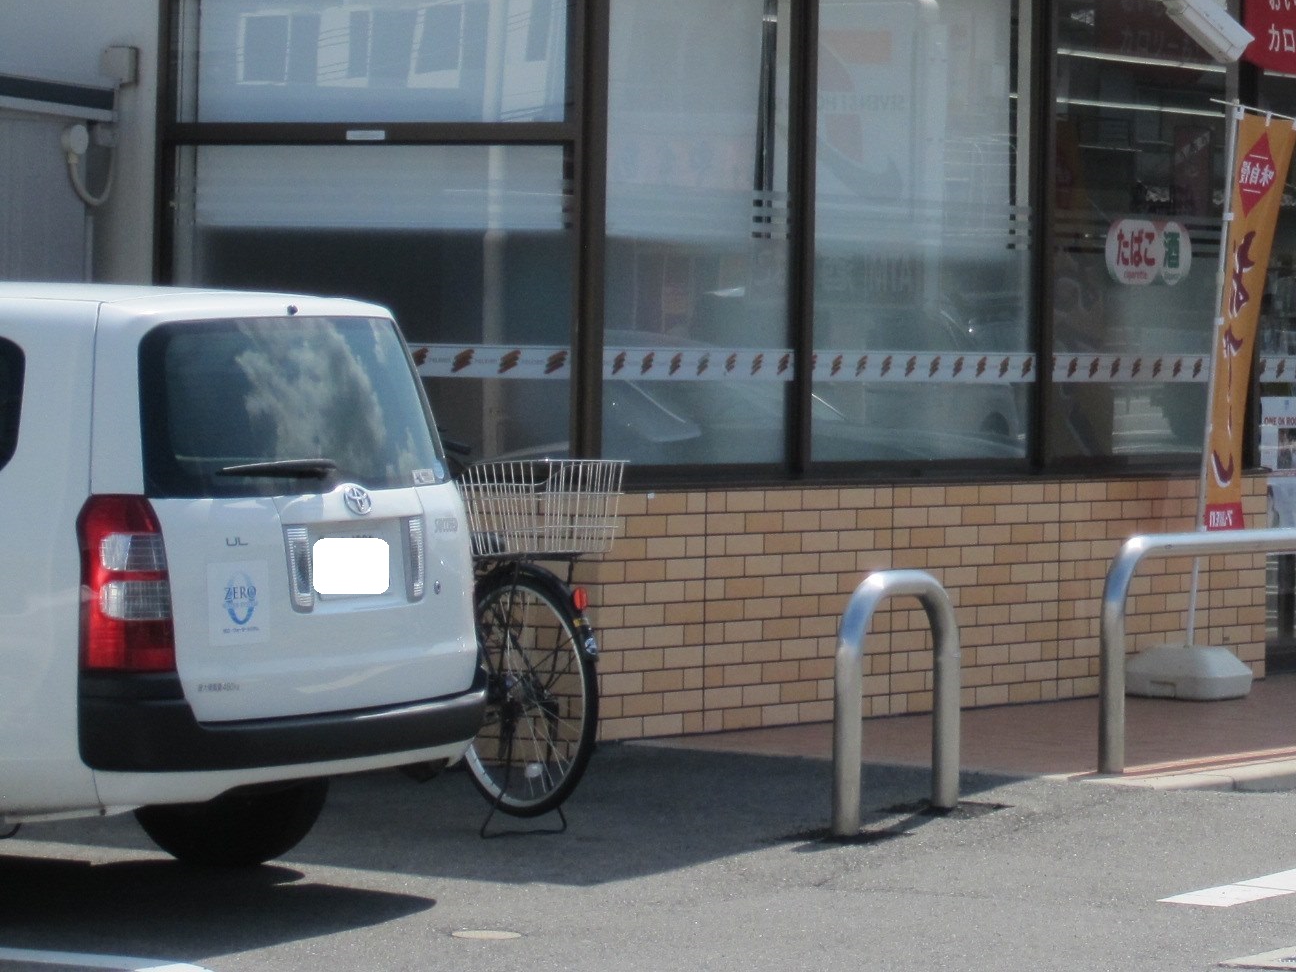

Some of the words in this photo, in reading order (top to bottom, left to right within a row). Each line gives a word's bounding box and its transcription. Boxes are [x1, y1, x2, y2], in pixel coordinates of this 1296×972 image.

[1116, 229, 1156, 267] たばこ
[225, 536, 249, 547] UL
[224, 586, 257, 601] ZERO
